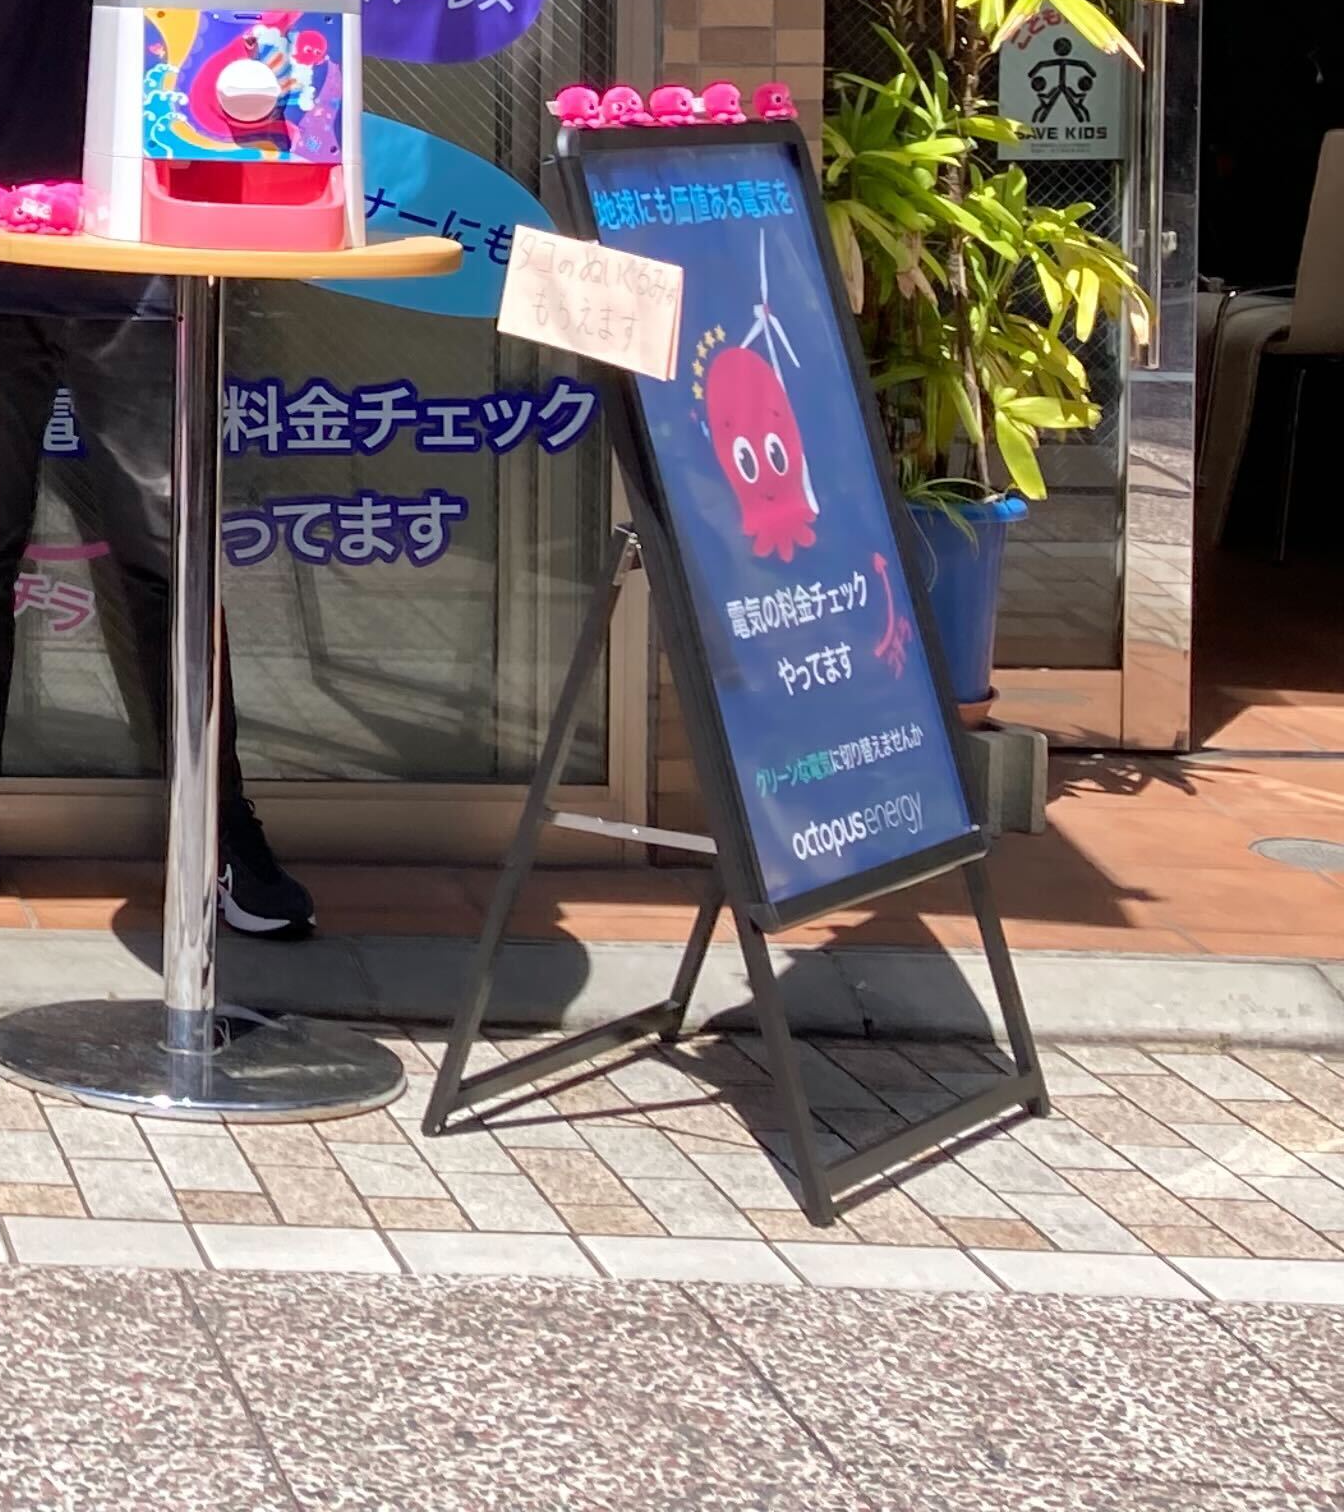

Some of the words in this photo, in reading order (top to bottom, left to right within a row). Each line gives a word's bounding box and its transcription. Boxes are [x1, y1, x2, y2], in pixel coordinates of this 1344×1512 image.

[1011, 8, 1069, 50] こども
[1065, 126, 1108, 139] KIDS
[593, 178, 794, 230] 地球にも価値ある電気を
[532, 289, 640, 352] もらえます
[725, 570, 868, 640] 電気の料金チェック
[777, 641, 853, 696] やってます
[755, 722, 924, 798] グリーンな電気に切り替えませんか
[792, 810, 867, 861] octopus
[864, 791, 924, 834] energy
